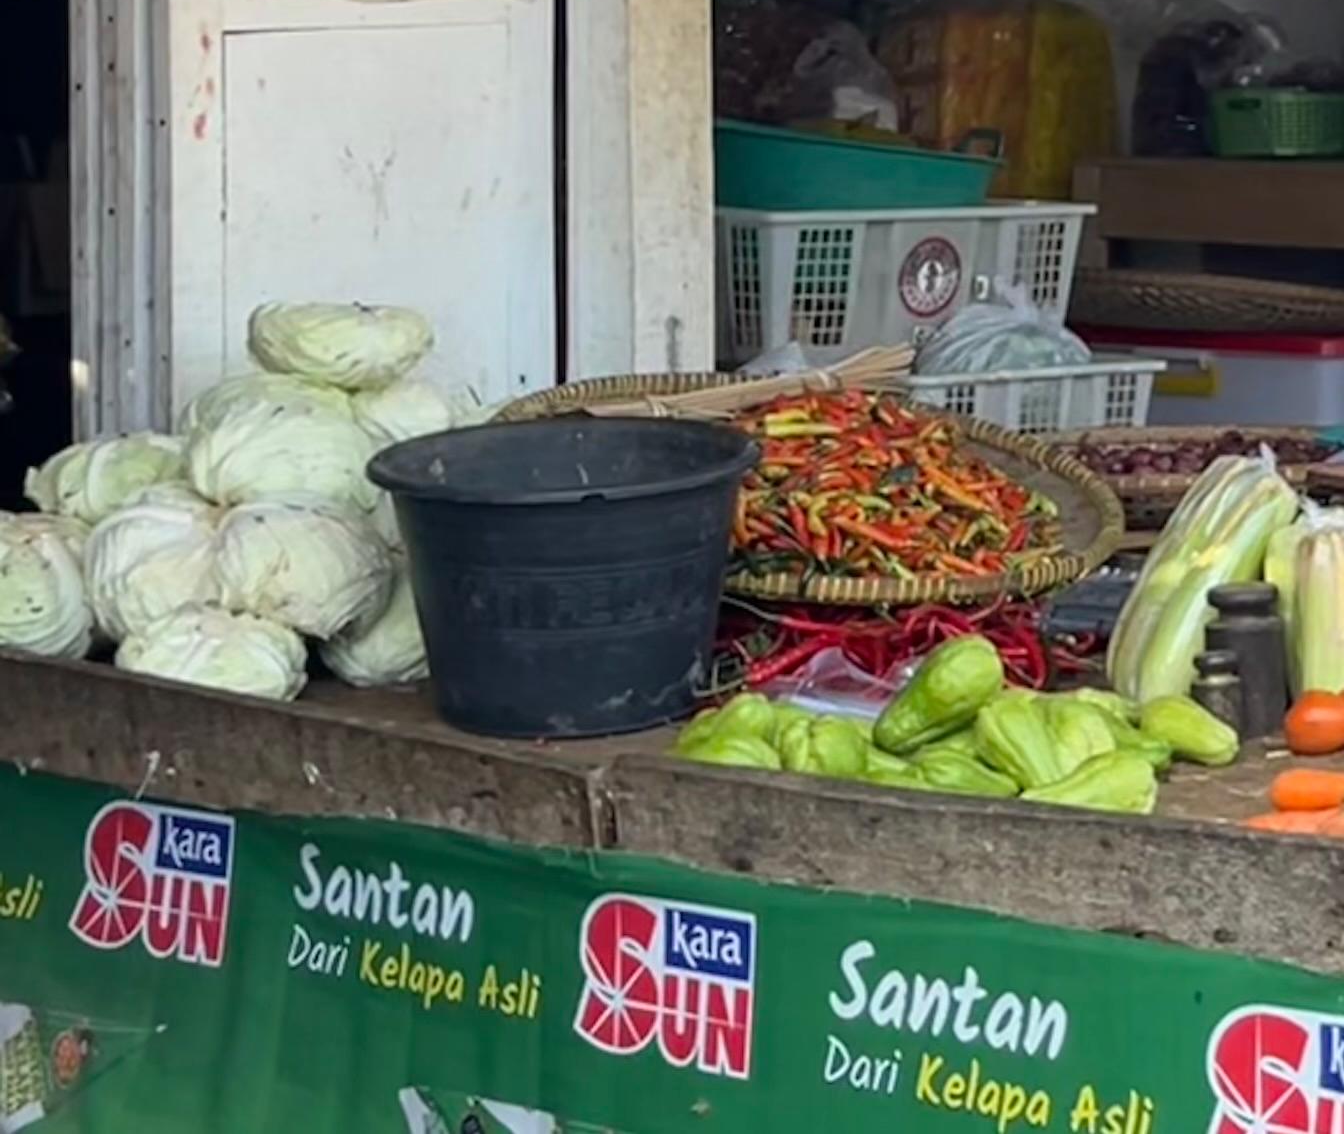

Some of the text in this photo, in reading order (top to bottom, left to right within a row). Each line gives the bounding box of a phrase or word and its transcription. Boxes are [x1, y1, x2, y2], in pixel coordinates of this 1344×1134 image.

[68, 800, 228, 966] SUN
[161, 818, 223, 866] kara
[0, 872, 44, 919] sli
[293, 844, 476, 942] Santan
[671, 911, 744, 967] kara
[287, 924, 541, 1020] Dari Kelapa Asli
[573, 893, 754, 1080] SUN
[828, 940, 1067, 1060] Santan
[823, 1035, 1155, 1134] Dari Kelapa Asli
